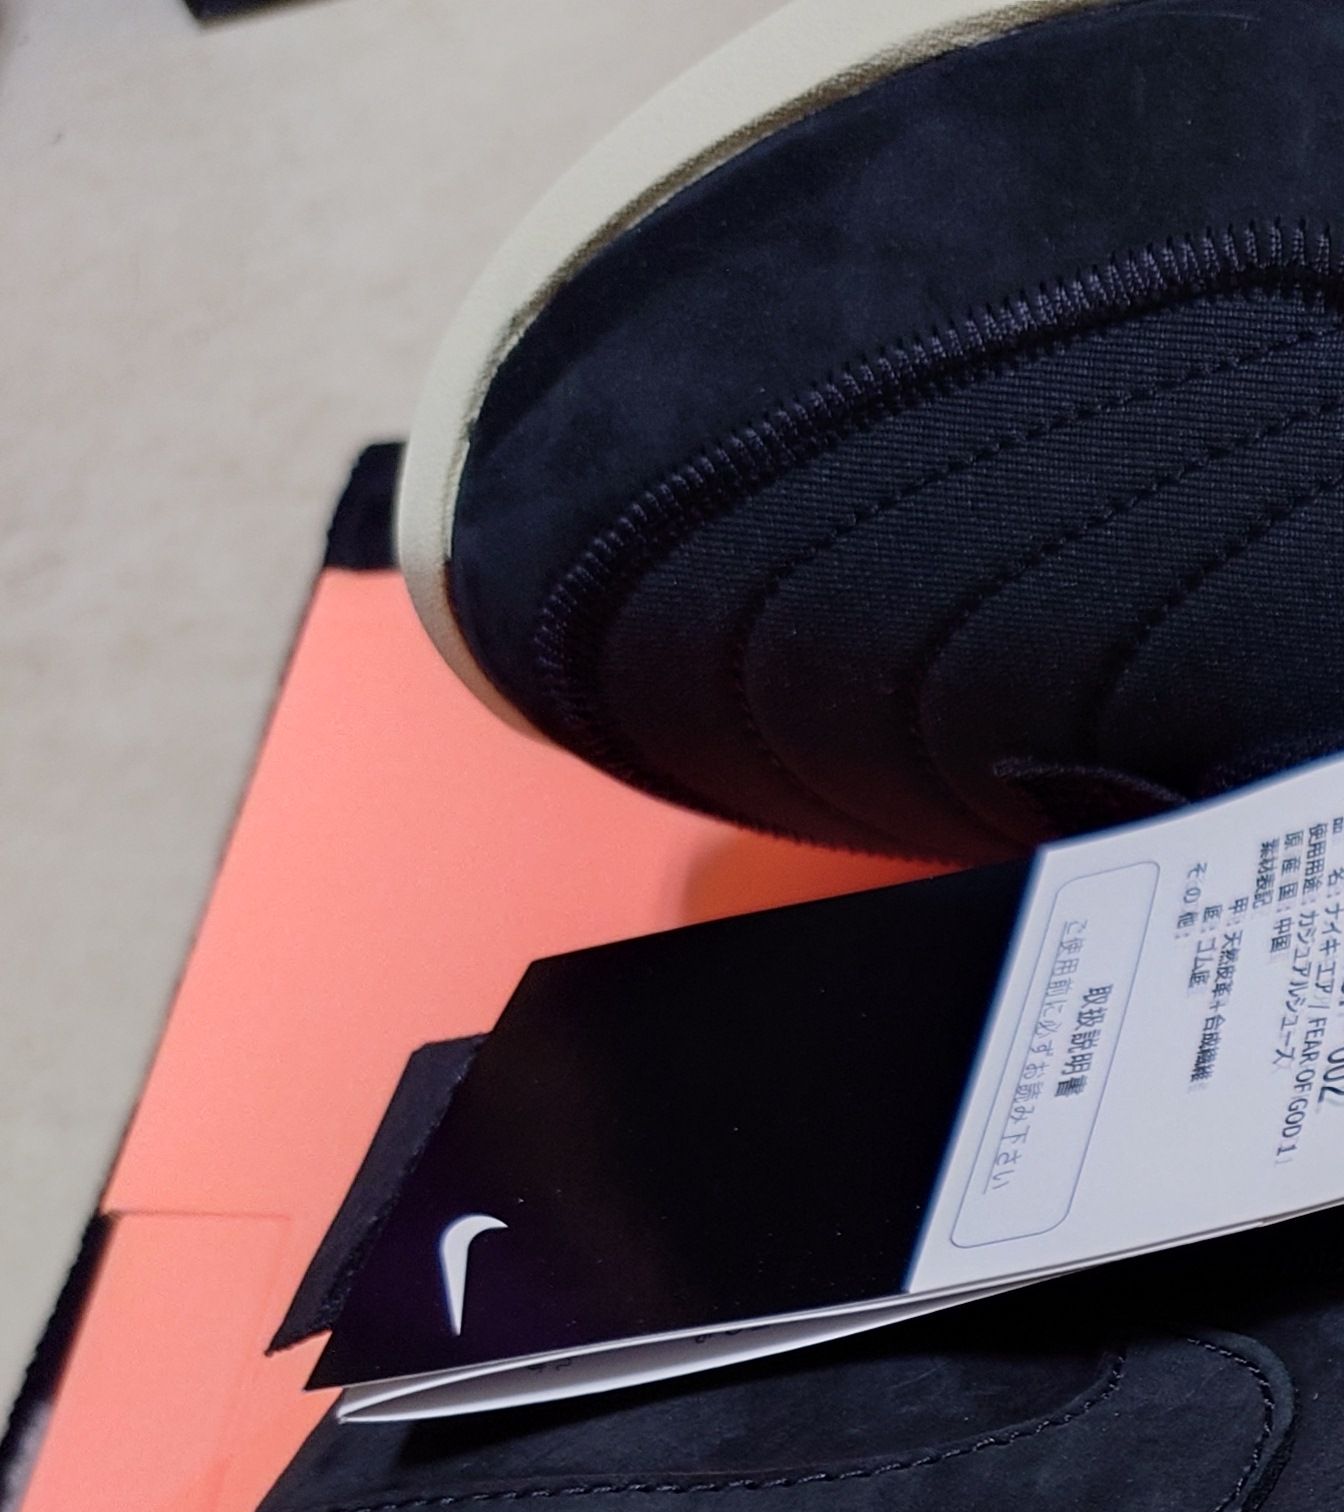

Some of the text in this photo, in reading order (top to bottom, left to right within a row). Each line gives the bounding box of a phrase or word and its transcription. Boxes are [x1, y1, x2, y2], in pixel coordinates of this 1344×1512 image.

[1053, 982, 1114, 1099] 取扱説明書
